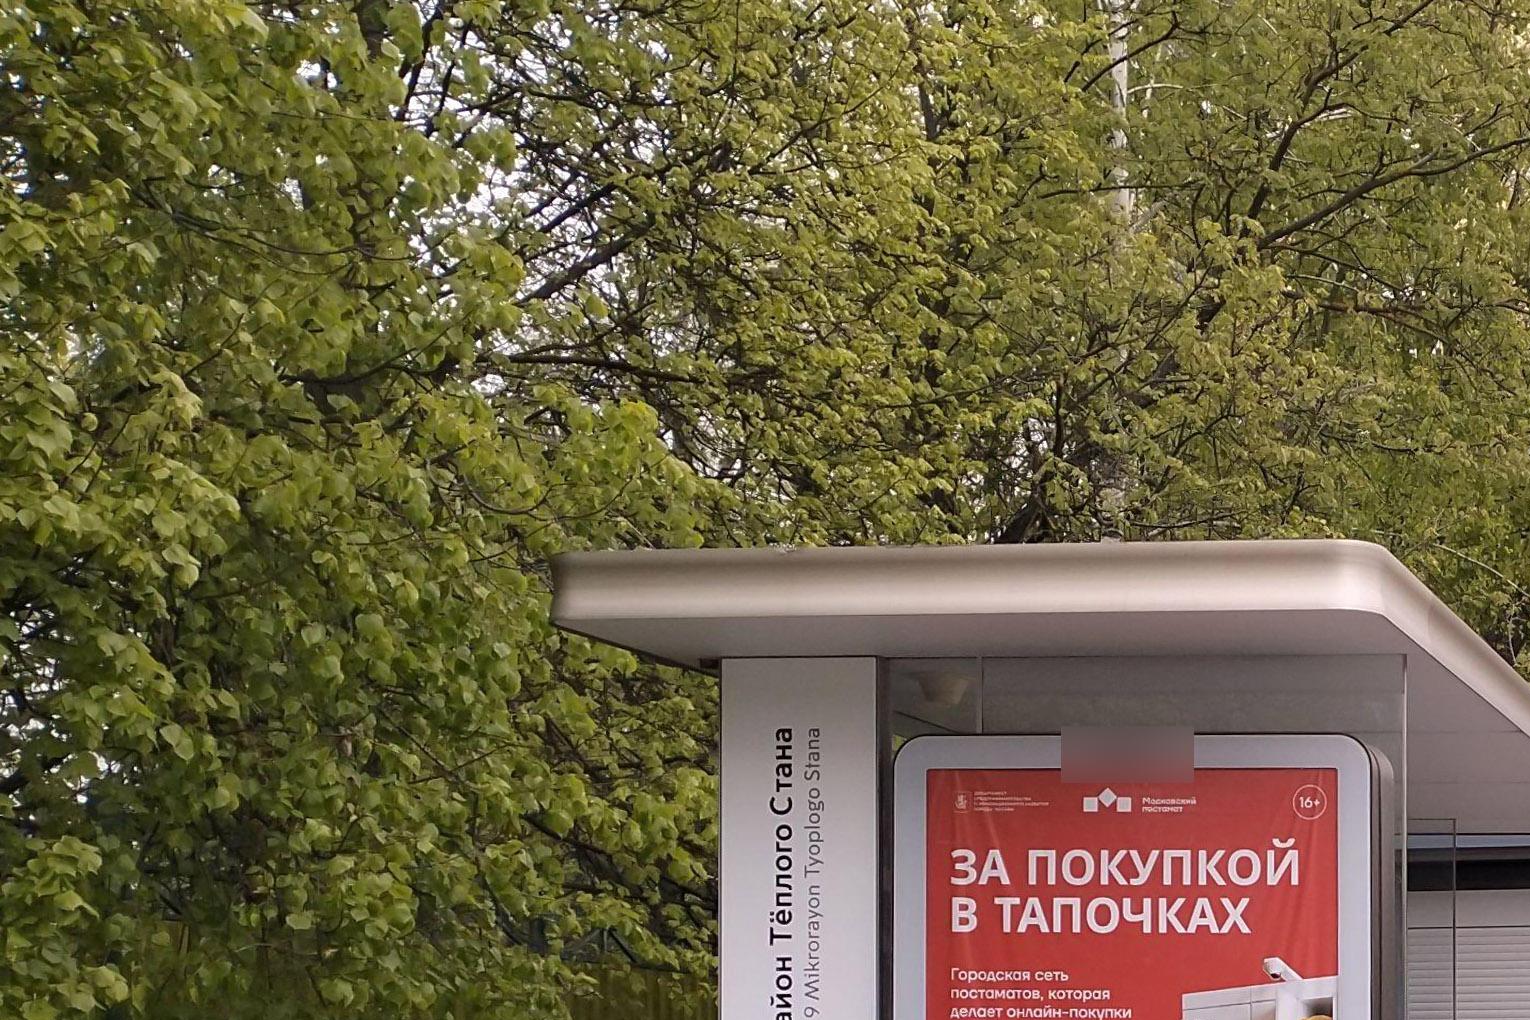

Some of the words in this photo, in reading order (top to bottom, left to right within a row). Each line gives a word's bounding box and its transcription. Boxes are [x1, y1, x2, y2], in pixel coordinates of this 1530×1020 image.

[770, 727, 793, 816] Стана
[804, 727, 820, 781] Stana
[1142, 796, 1196, 805] Московский
[1298, 796, 1321, 809] 16+
[803, 787, 825, 878] Tyoplogo
[950, 849, 1010, 886] ЗА
[1027, 838, 1300, 886] ПОКУПКОЙ
[769, 824, 793, 946] Тёплого
[951, 897, 978, 933] В
[993, 896, 1252, 934] ТАПОЧКАХ
[803, 886, 825, 1000] Mikrorayon
[951, 968, 1031, 983] Городская
[1035, 970, 1069, 981] сеть
[803, 1006, 820, 1018] 9
[950, 1007, 1003, 1019] делает
[1007, 1005, 1132, 1020] онлайн-покупки
[951, 989, 1044, 1001] постаматов,
[1048, 989, 1111, 1002] которая
